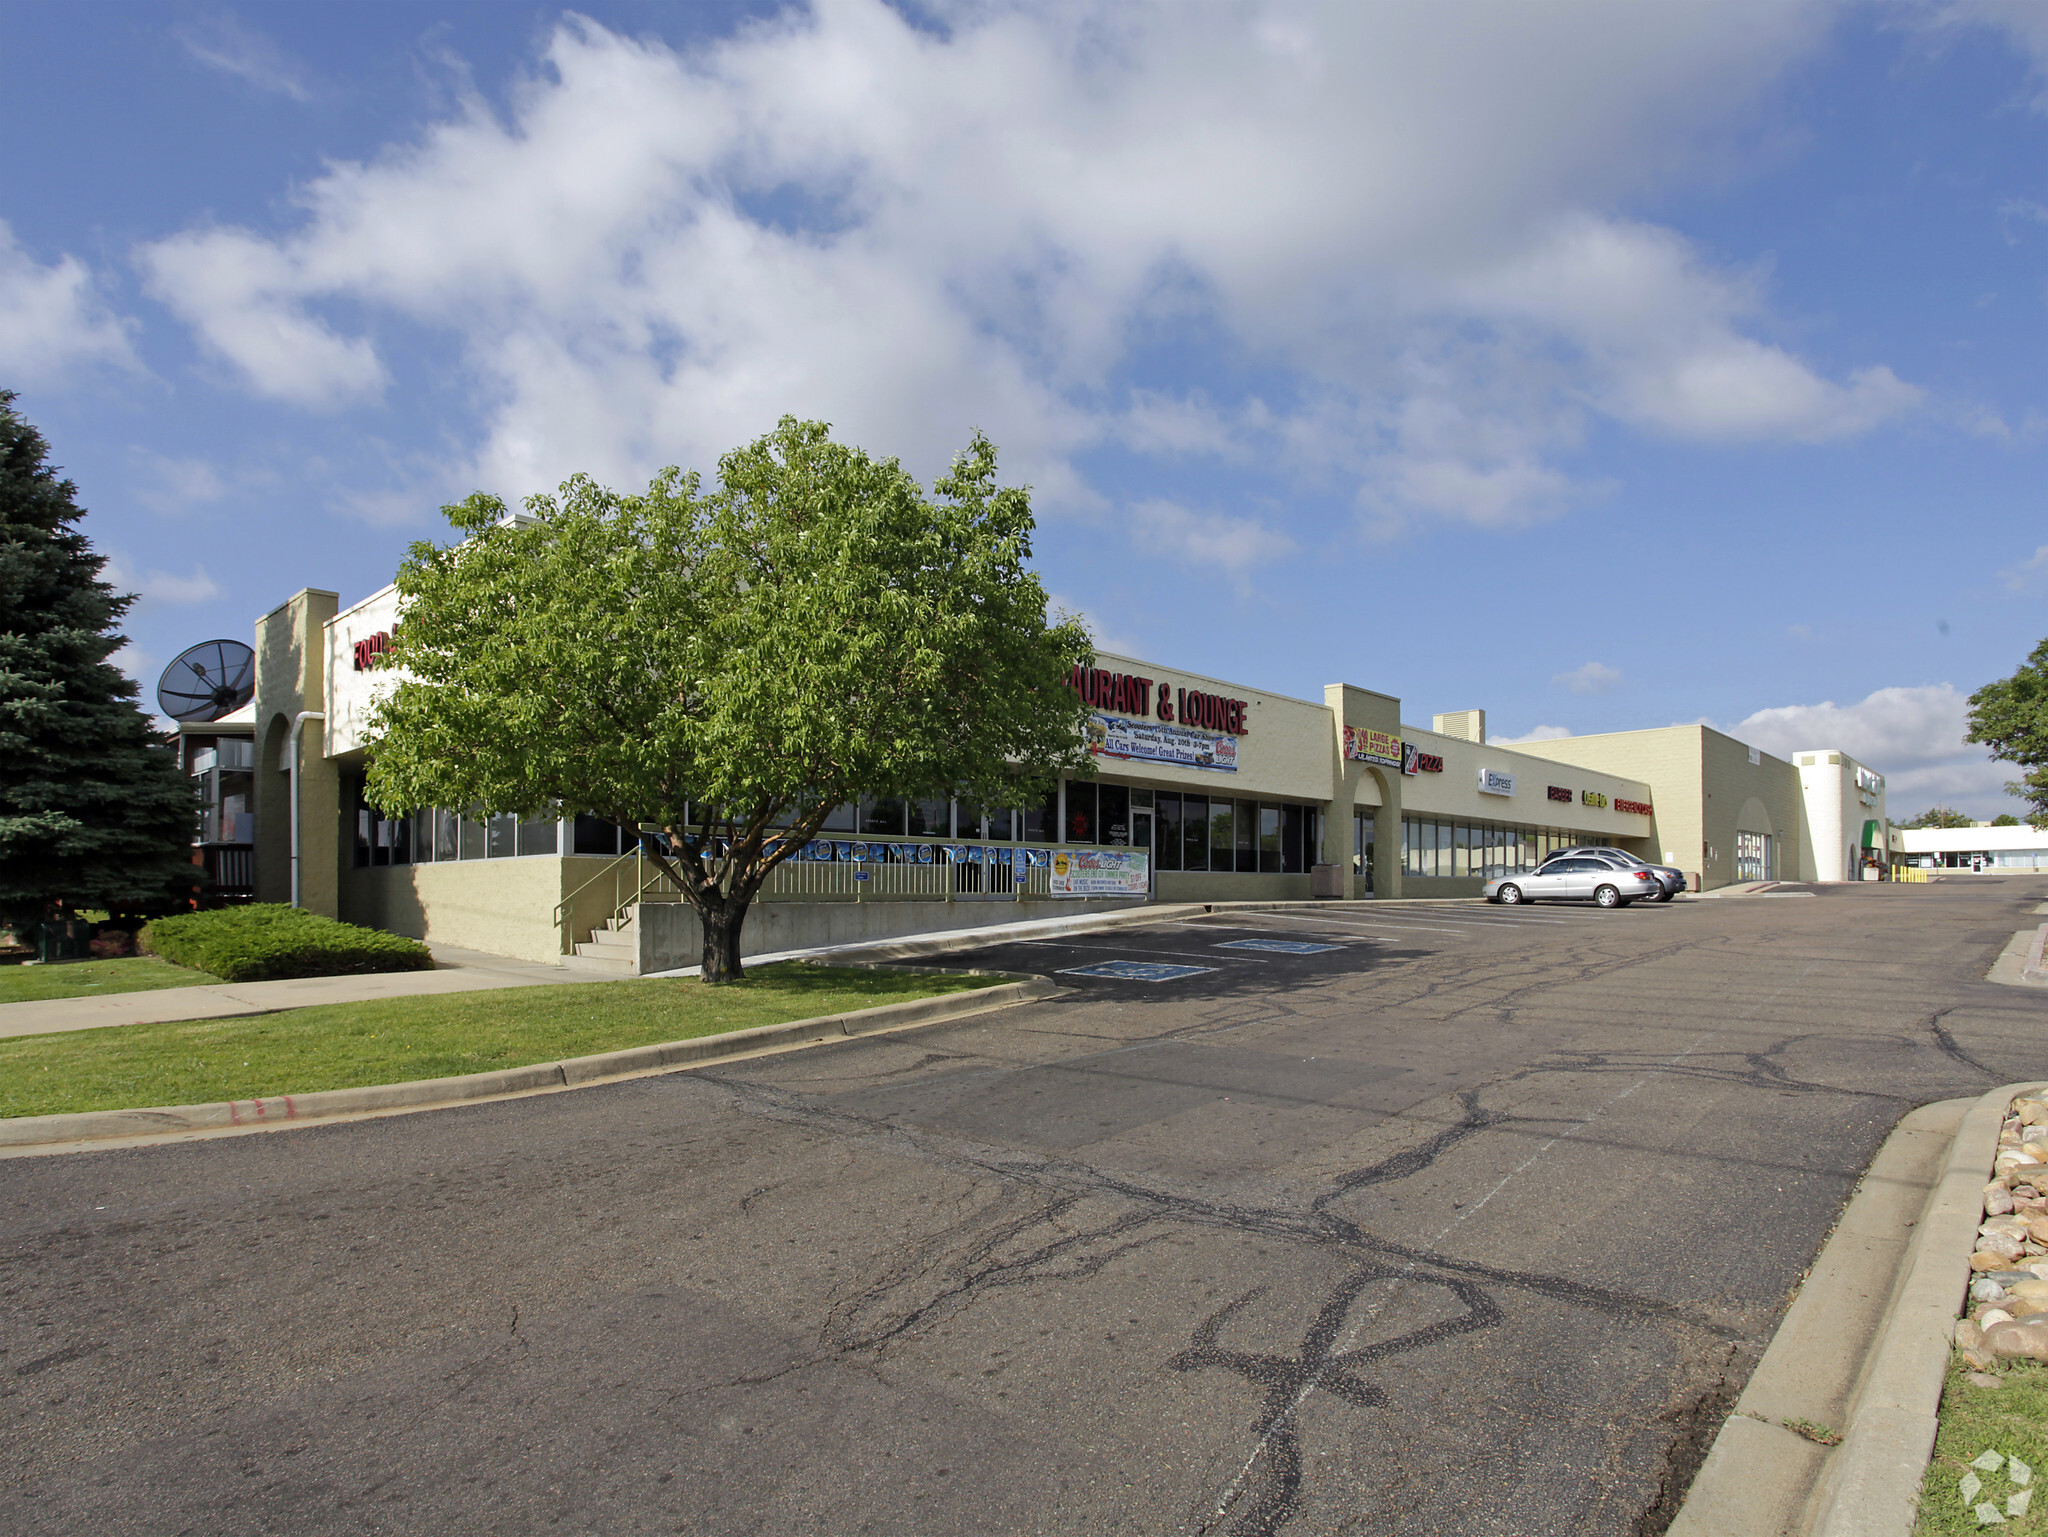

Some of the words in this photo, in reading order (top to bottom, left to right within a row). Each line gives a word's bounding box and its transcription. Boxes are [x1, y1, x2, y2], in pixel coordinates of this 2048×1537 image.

[1062, 664, 1153, 716] AURANT
[1157, 682, 1175, 722] &
[1179, 687, 1249, 735] LOUNGE
[1369, 731, 1389, 745] LARGE
[1105, 738, 1114, 750] All
[1114, 740, 1130, 752] Cars
[1130, 742, 1158, 757] Welcome!
[1158, 746, 1175, 759] Great
[1176, 748, 1195, 761] Prizes!
[1369, 742, 1391, 756] PIZZAS
[1420, 754, 1444, 773] PIZZA
[1079, 855, 1100, 870] Coors
[1100, 860, 1122, 870] LIGHT
